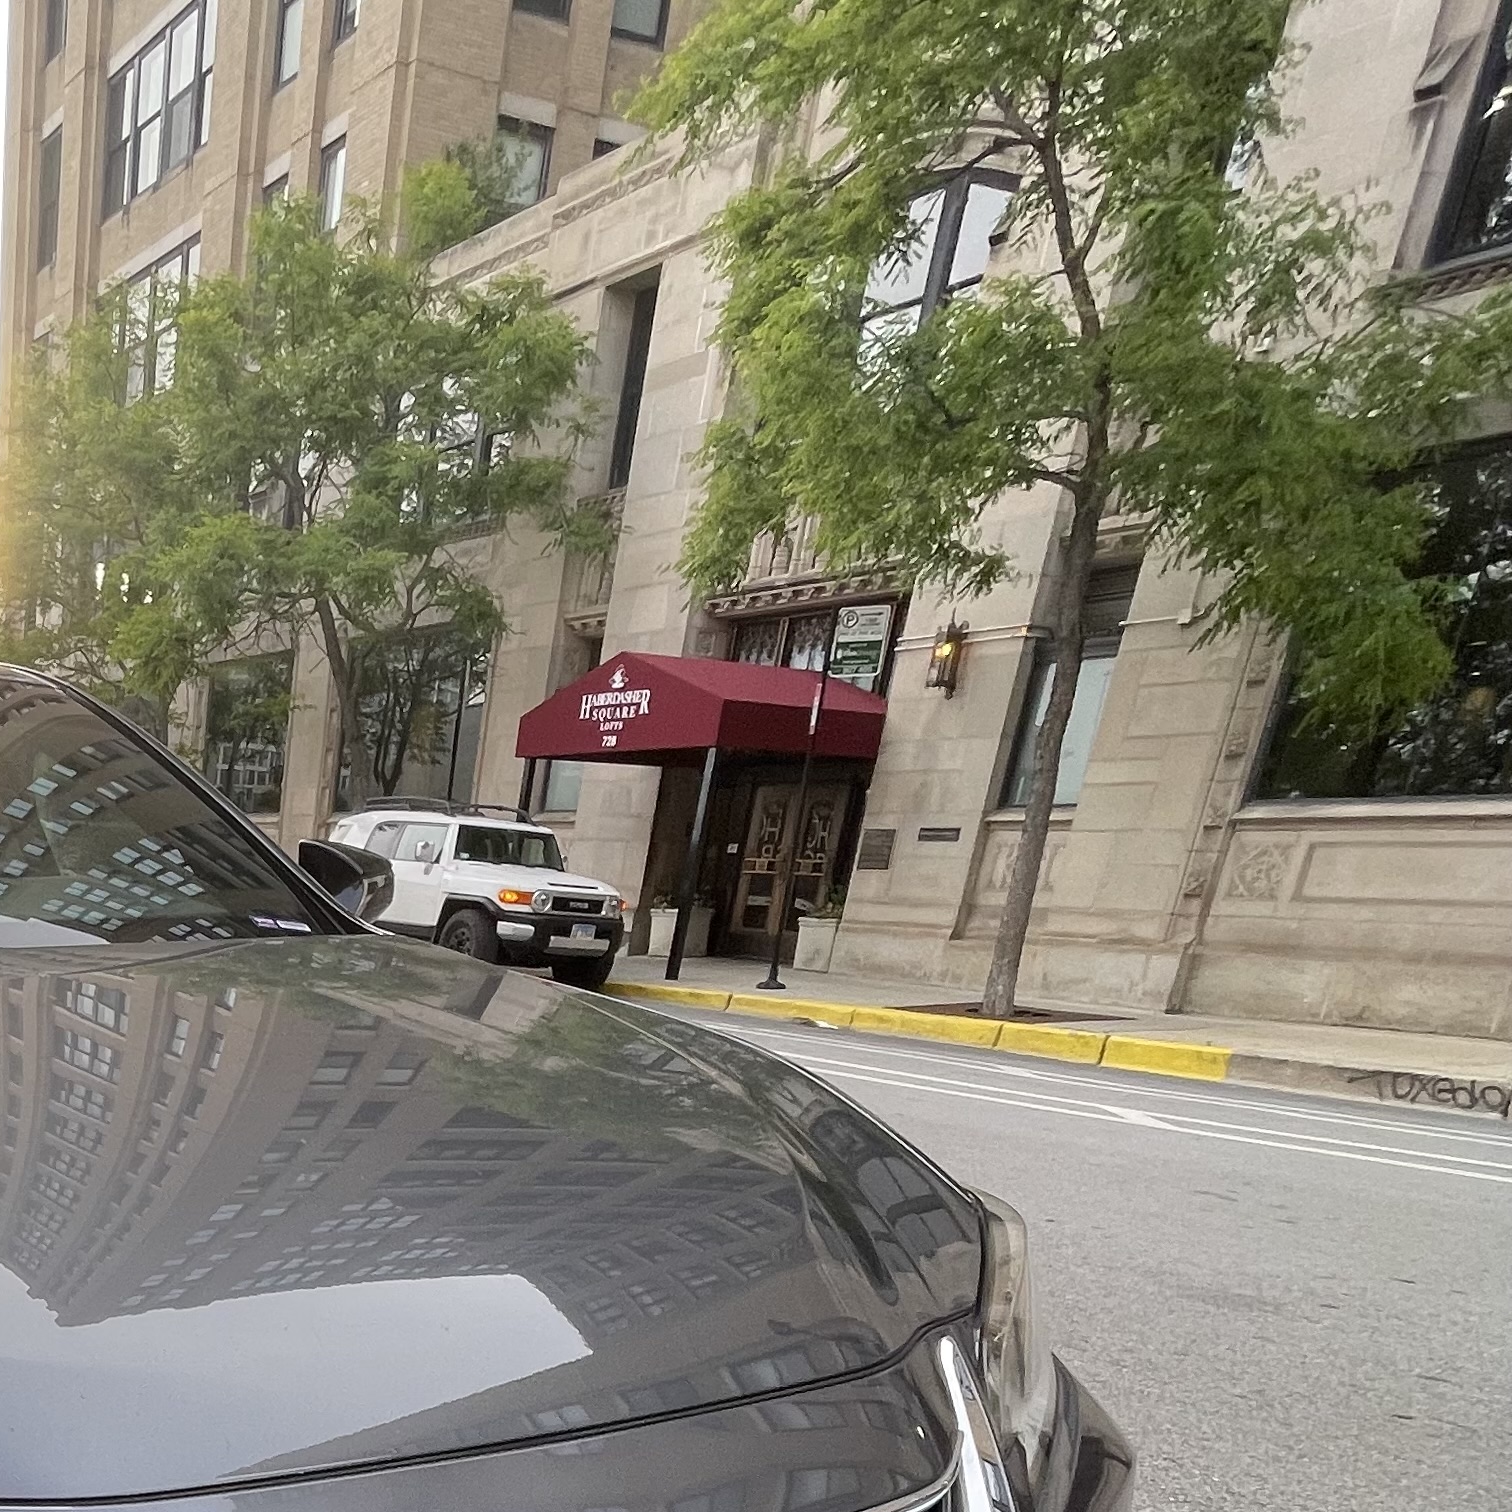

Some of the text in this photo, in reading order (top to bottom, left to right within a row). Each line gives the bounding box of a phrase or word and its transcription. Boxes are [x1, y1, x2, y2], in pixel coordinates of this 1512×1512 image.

[579, 689, 651, 719] HABERDASHER
[591, 706, 638, 721] SQUARE
[599, 721, 624, 732] LOFTS
